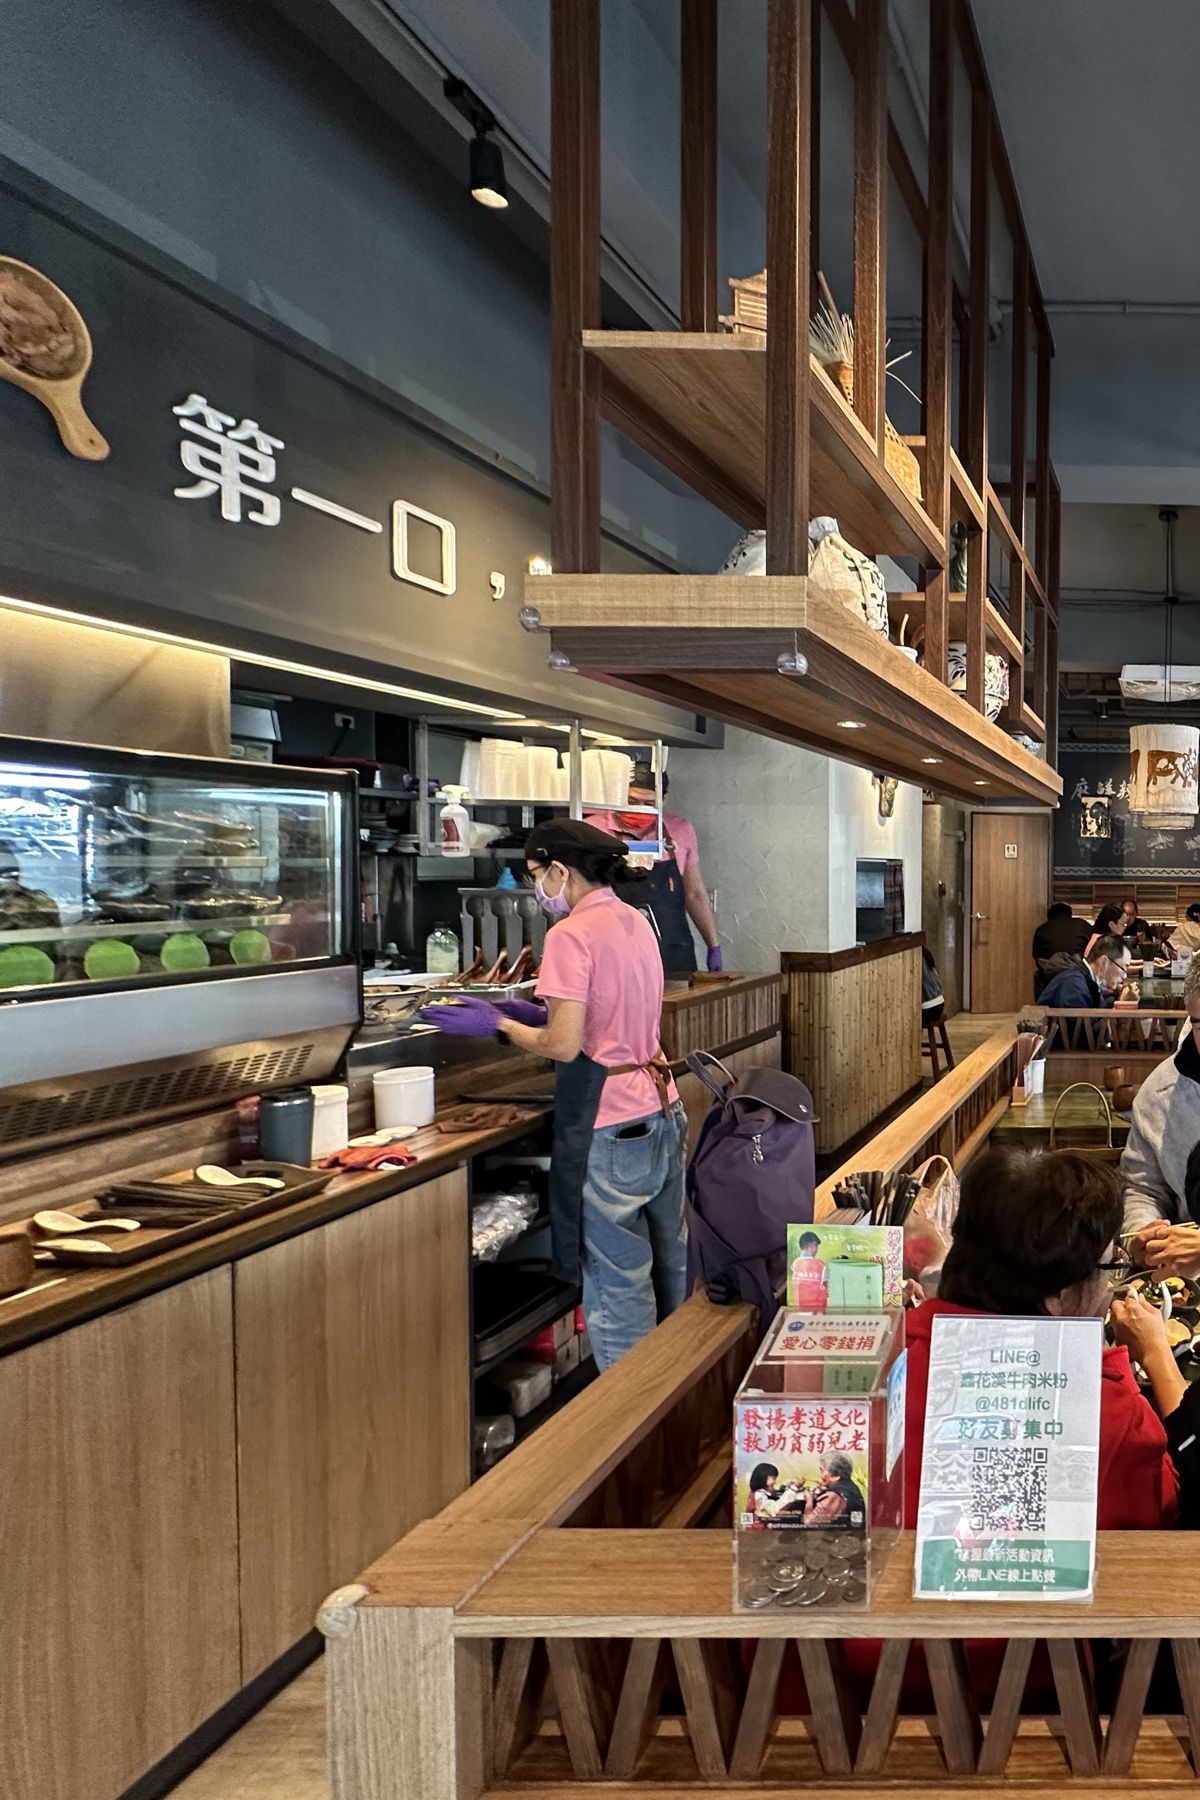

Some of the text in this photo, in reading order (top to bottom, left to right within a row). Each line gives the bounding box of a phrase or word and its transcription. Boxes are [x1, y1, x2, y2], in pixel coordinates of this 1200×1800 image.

[779, 1335, 876, 1351] 愛心零錢捐
[989, 1349, 1041, 1366] LINE@
[742, 1406, 867, 1431] 發揚孝道文化
[742, 1430, 867, 1454] 救助貧弱兒老
